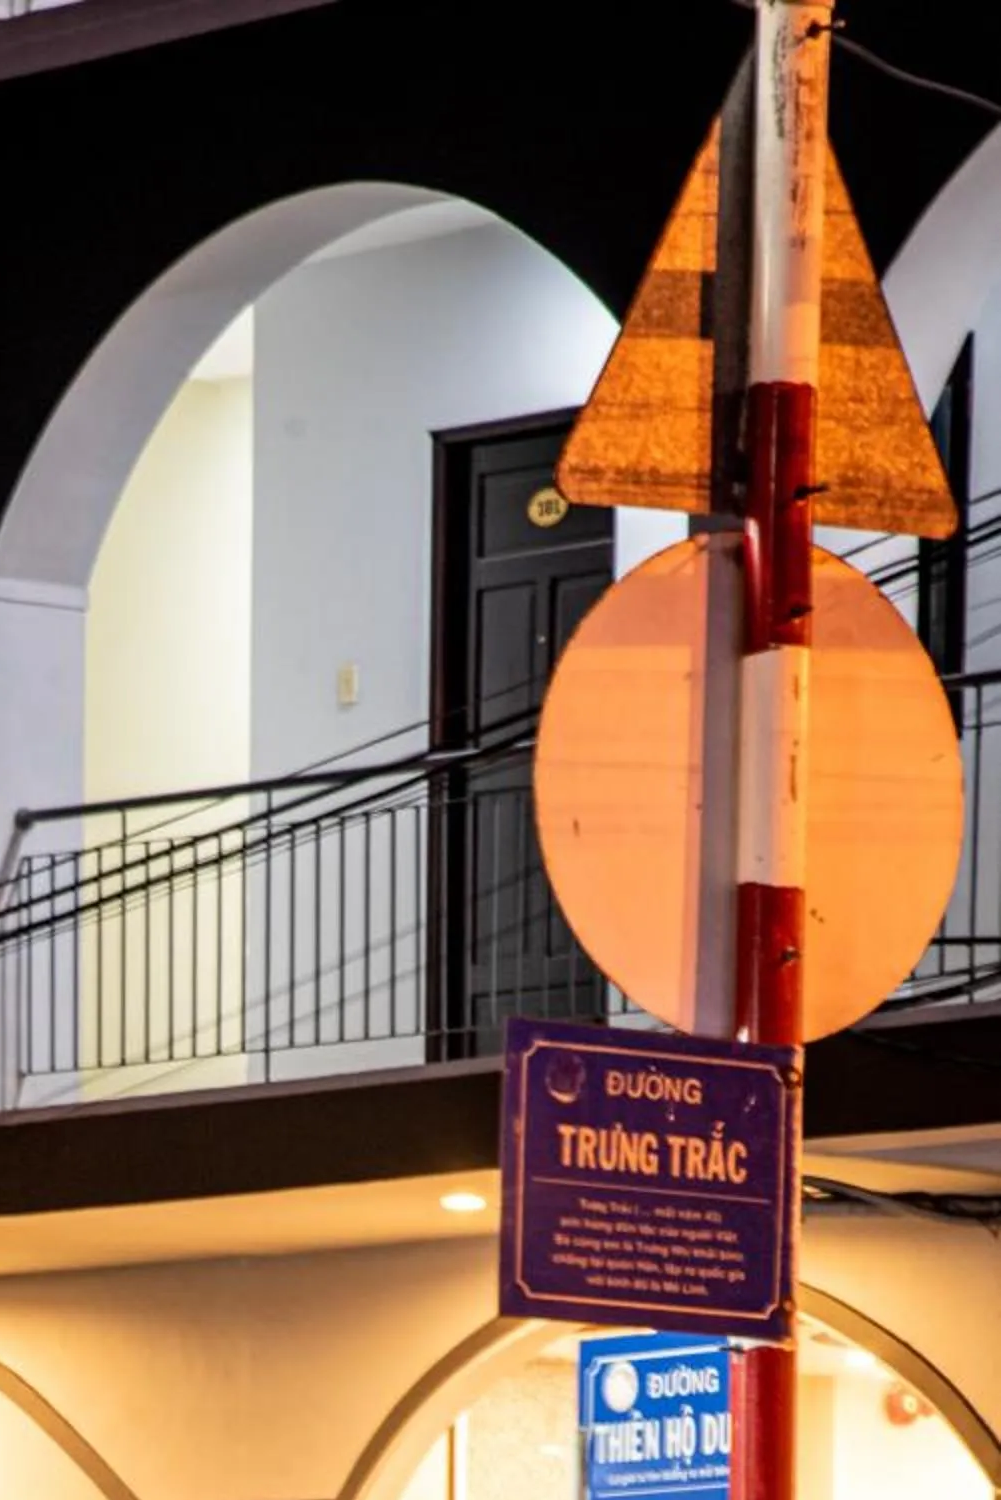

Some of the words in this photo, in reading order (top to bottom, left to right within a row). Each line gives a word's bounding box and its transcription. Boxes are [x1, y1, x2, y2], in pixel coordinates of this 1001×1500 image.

[605, 1064, 703, 1104] ĐƯỜNG
[556, 1121, 659, 1175] TRƯNG
[666, 1119, 748, 1184] TRẮC
[646, 1364, 720, 1399] ĐƯỜNG
[663, 1403, 697, 1465] HỘ
